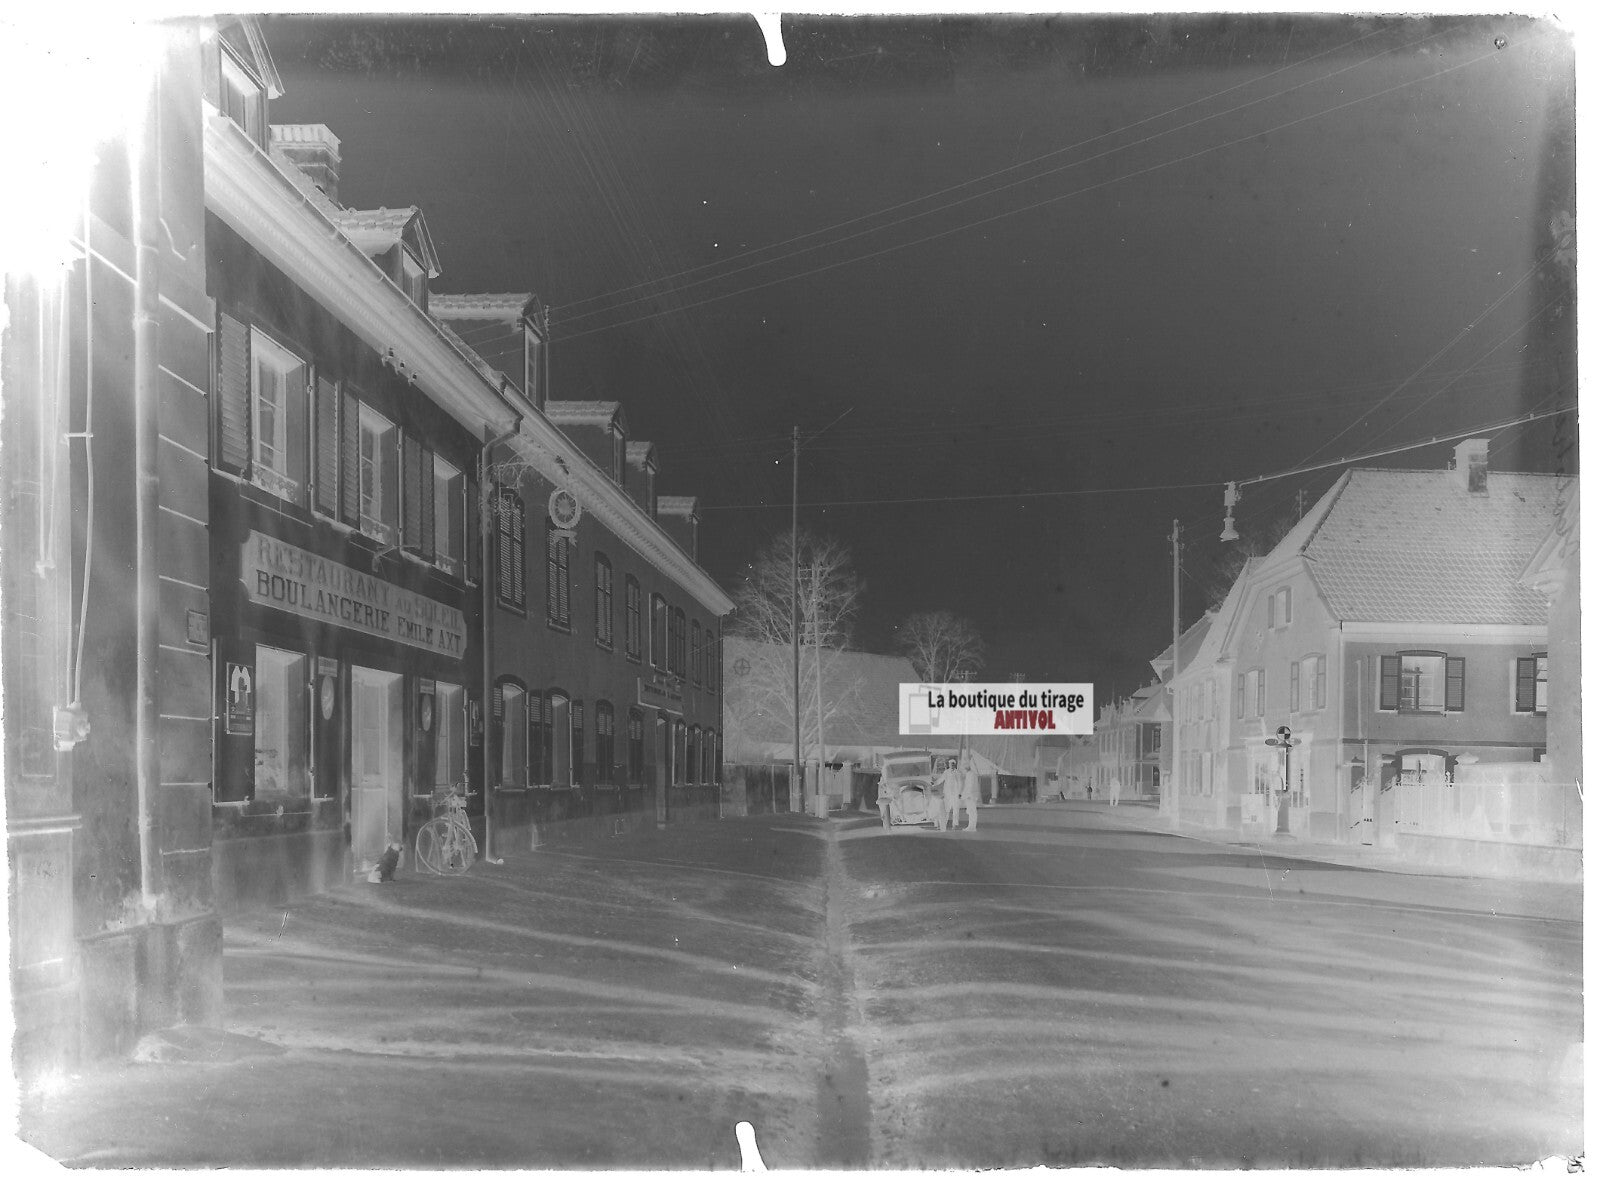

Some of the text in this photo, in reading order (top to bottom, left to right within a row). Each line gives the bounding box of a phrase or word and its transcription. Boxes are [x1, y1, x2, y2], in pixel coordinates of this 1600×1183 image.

[256, 536, 391, 608] RESTAURANT
[256, 568, 463, 654] BOULANGERIE EMILE AXT
